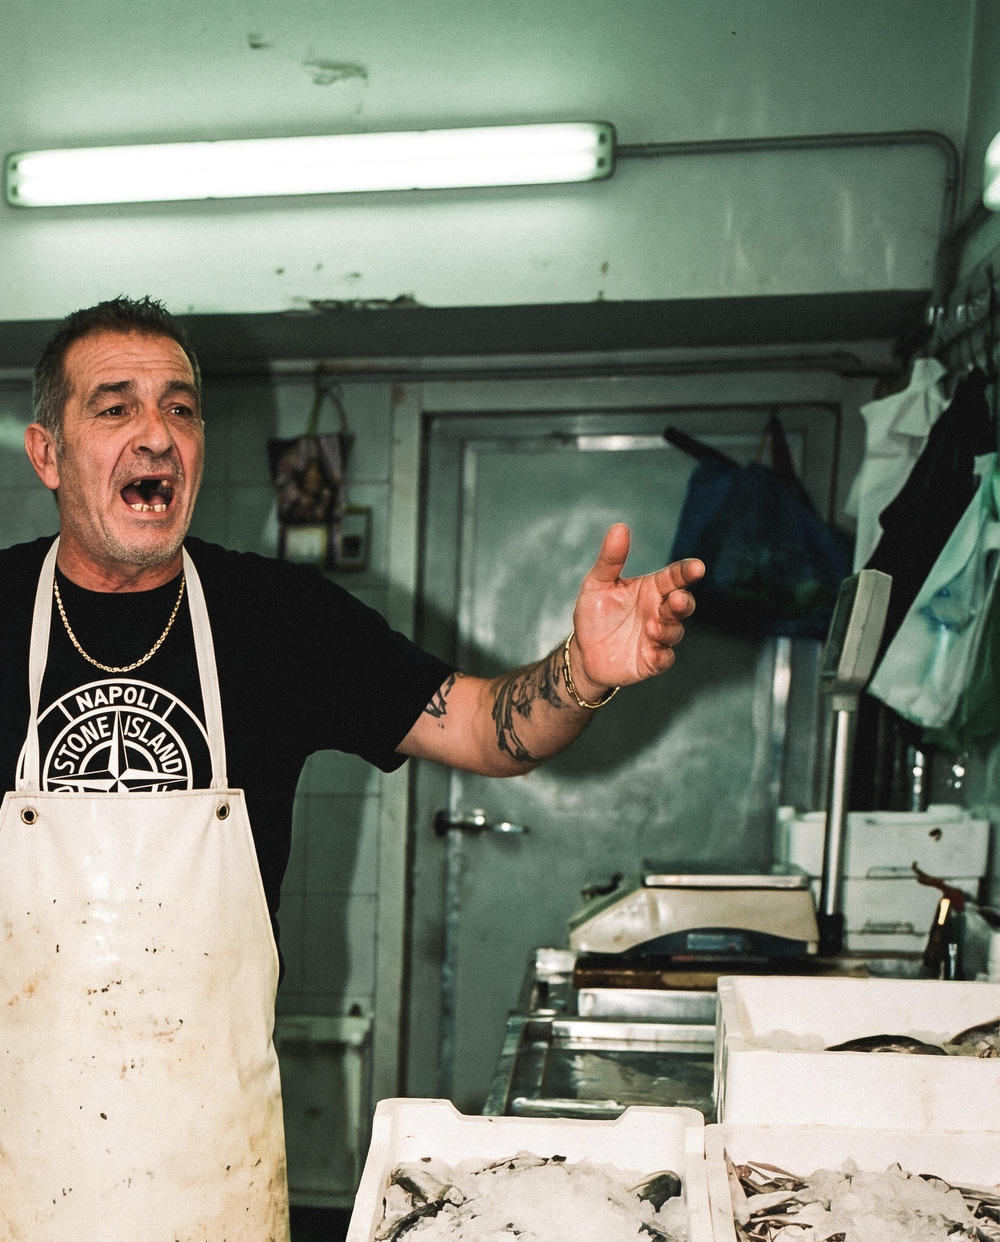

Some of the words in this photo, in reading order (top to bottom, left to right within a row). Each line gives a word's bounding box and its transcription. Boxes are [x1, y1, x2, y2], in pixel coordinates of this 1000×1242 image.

[75, 686, 159, 713] NAPOLI
[53, 715, 112, 775] STONE
[123, 715, 183, 774] ISLAND
